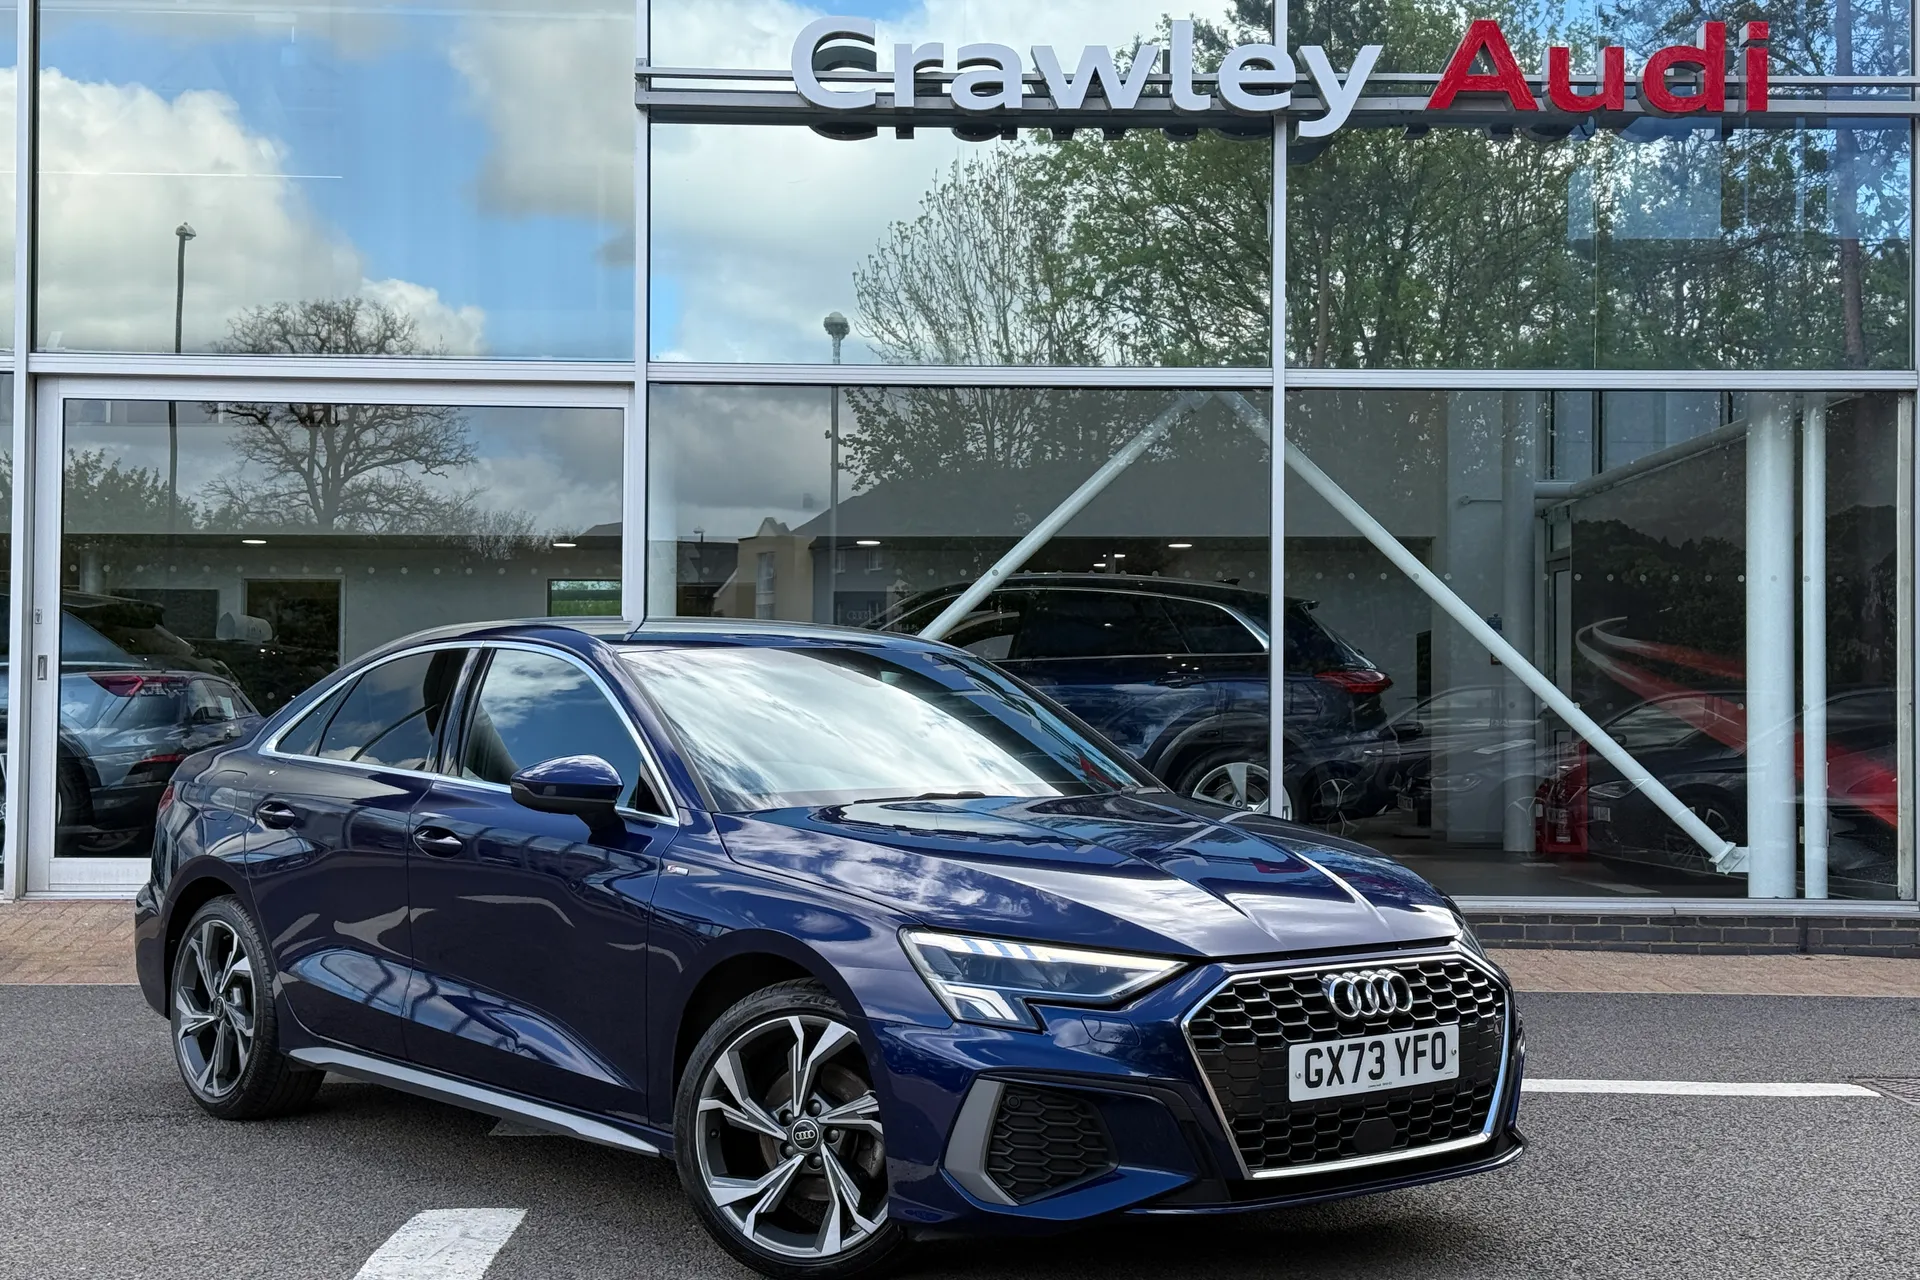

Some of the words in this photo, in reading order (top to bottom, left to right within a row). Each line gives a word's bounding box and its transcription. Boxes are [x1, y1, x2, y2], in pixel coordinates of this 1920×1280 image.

[790, 15, 1383, 138] Crawley
[1424, 18, 1769, 113] Audi
[1304, 1040, 1385, 1089] GX73
[1394, 1031, 1447, 1077] YFO
